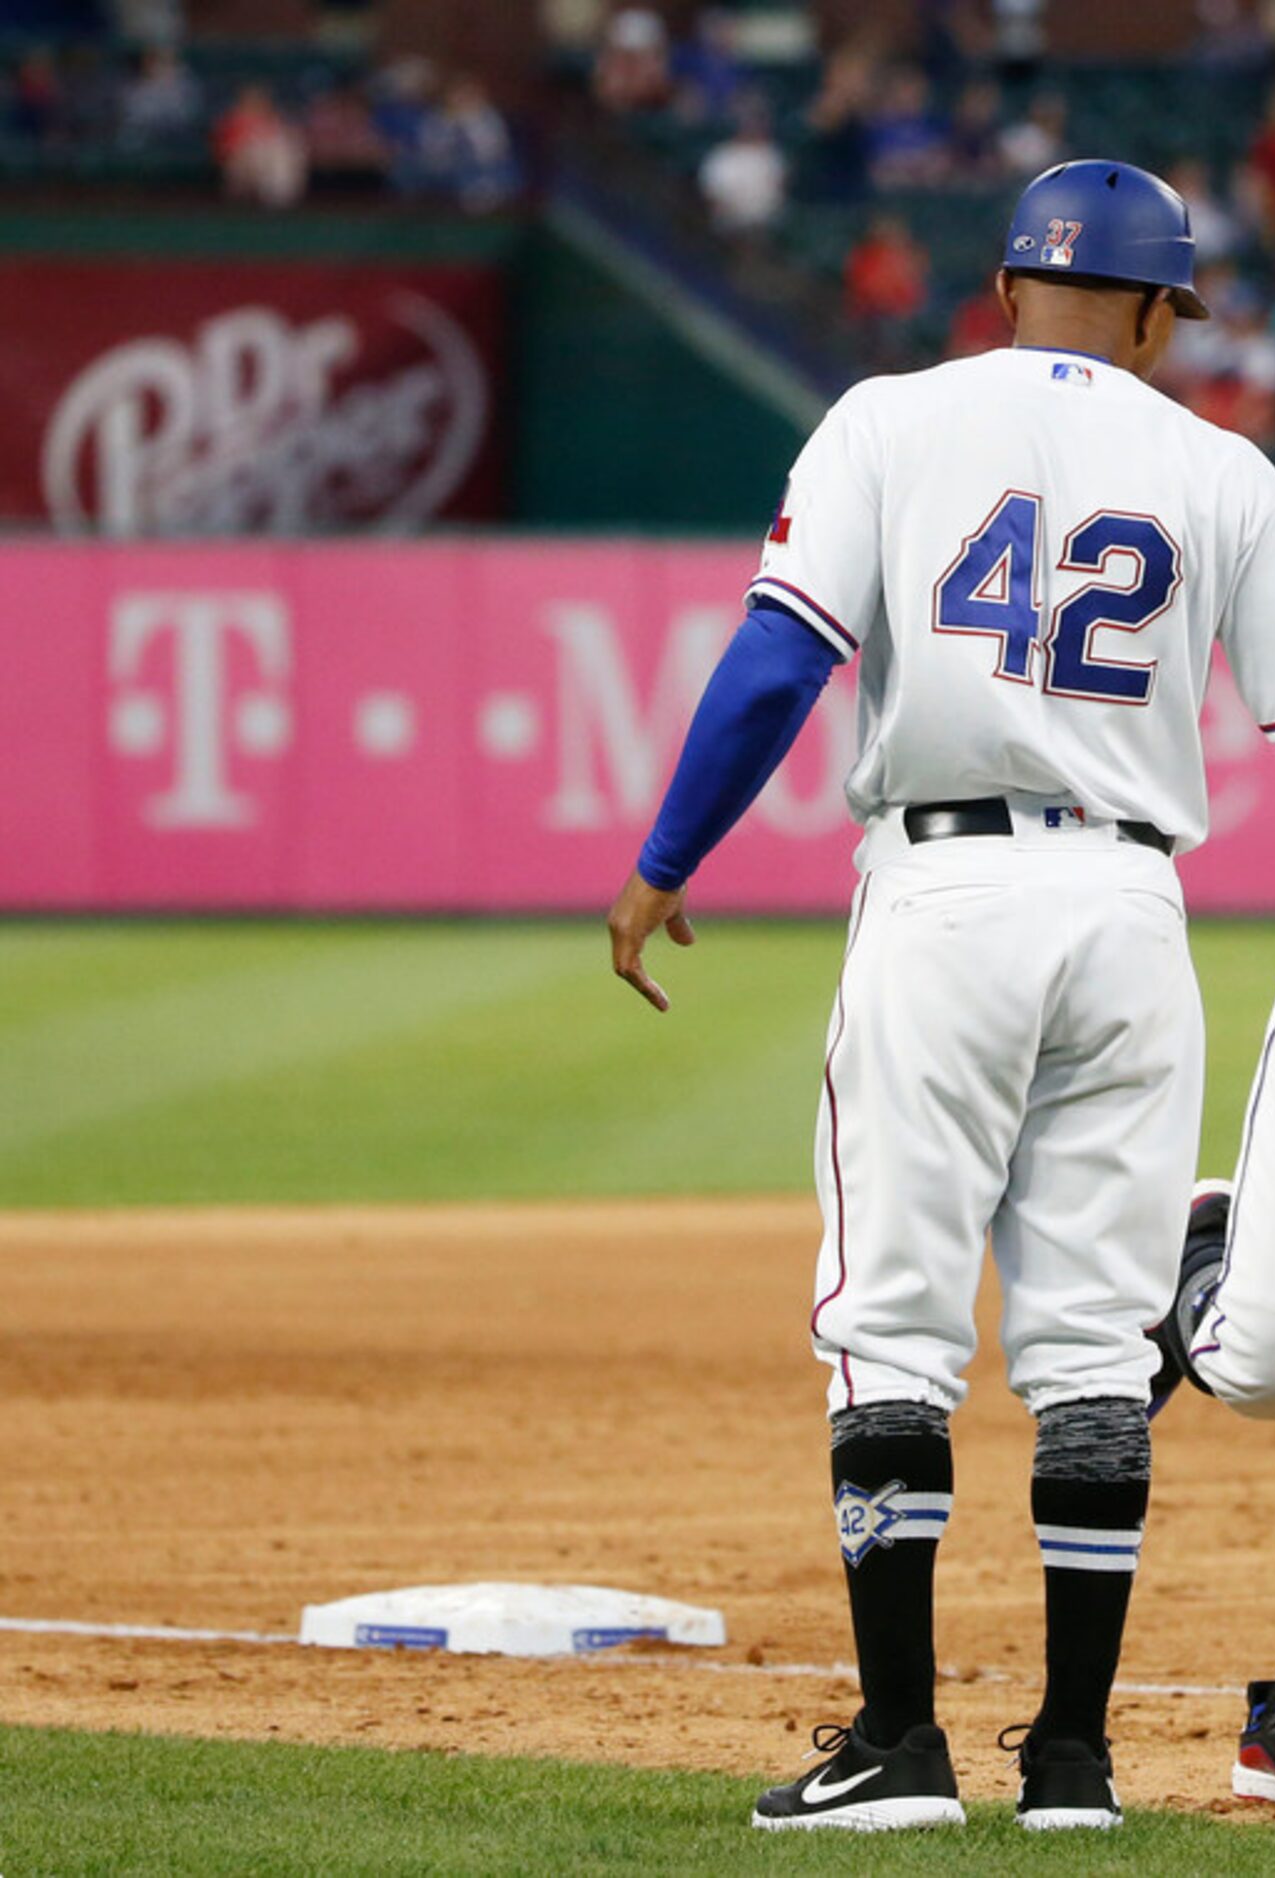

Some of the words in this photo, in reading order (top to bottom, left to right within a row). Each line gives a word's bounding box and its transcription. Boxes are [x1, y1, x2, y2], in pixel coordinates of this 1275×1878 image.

[1046, 218, 1082, 247] 37
[931, 488, 1183, 706] 42
[841, 1505, 866, 1536] 42
